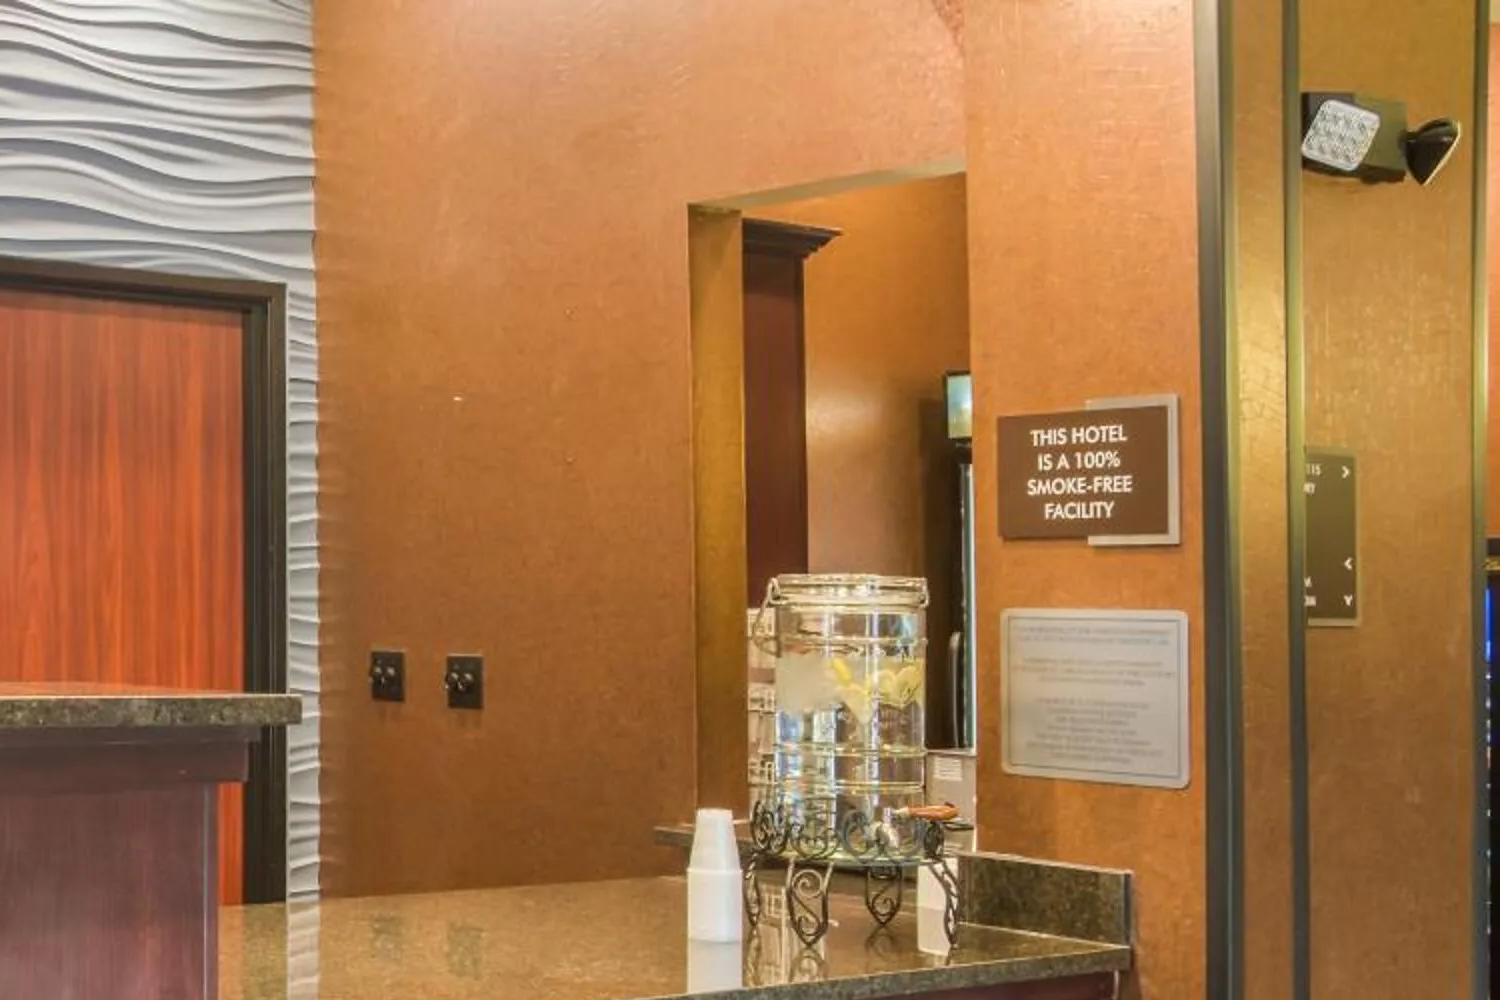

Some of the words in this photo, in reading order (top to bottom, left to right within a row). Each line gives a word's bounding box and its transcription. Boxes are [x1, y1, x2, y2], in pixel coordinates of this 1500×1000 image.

[1030, 426, 1068, 447] THIS
[1071, 424, 1128, 445] HOTEL
[1037, 453, 1053, 472] IS
[1056, 453, 1070, 470] A
[1074, 451, 1121, 469] 100%
[1027, 475, 1133, 496] SMOKE-FREE
[1044, 501, 1115, 520] FACILITY
